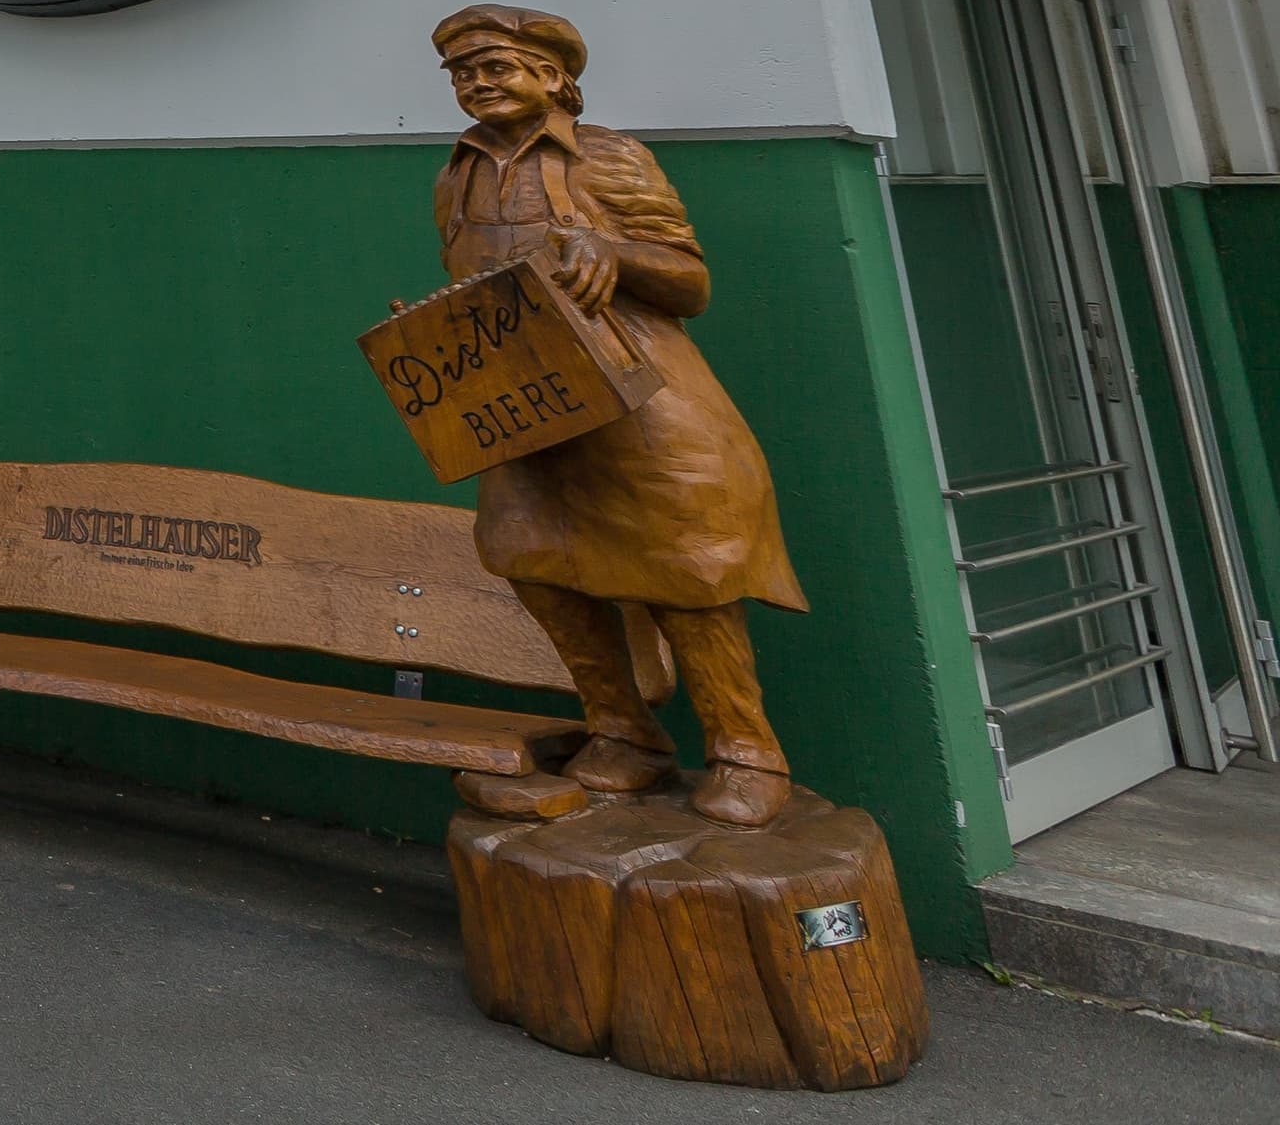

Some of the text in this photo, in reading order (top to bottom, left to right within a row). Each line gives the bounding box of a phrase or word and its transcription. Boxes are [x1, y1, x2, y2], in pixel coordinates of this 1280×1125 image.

[389, 271, 540, 417] Distel
[460, 371, 586, 449] BIERE
[42, 506, 264, 567] DISTELHÄUSER
